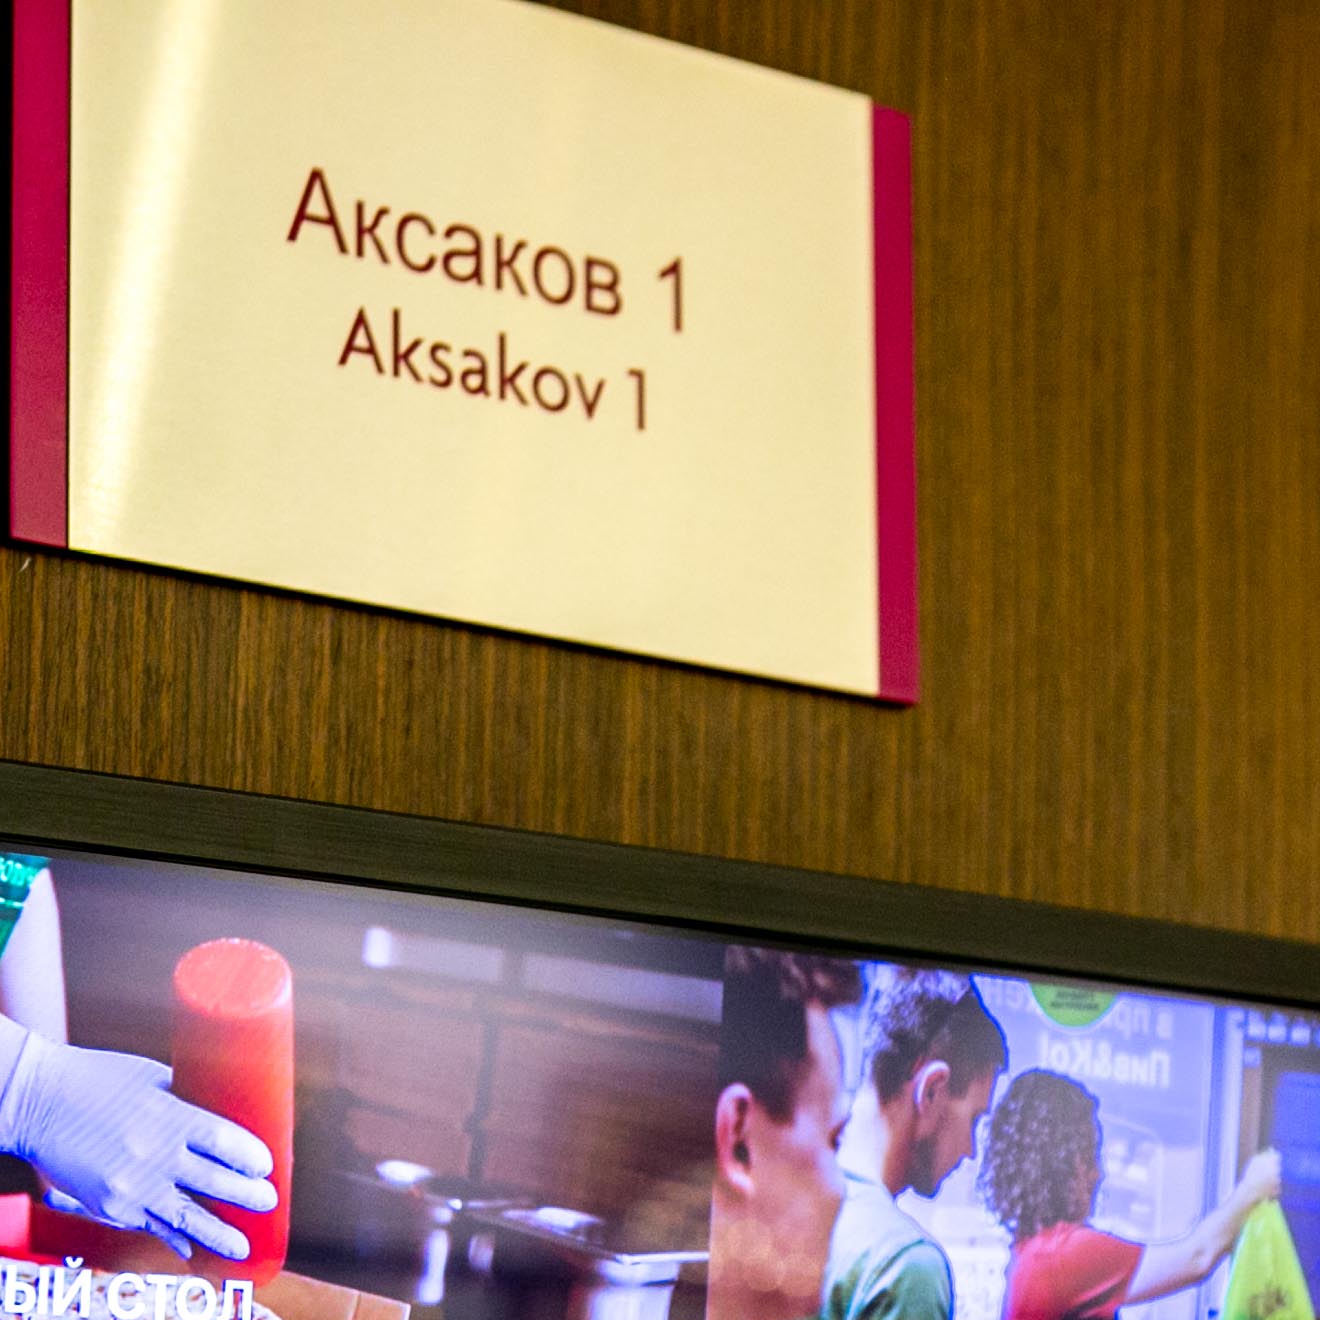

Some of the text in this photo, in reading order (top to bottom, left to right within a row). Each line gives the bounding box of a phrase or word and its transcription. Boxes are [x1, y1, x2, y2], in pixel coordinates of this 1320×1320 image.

[286, 166, 683, 333] Аксаков 1
[337, 307, 646, 431] Aksakov 1
